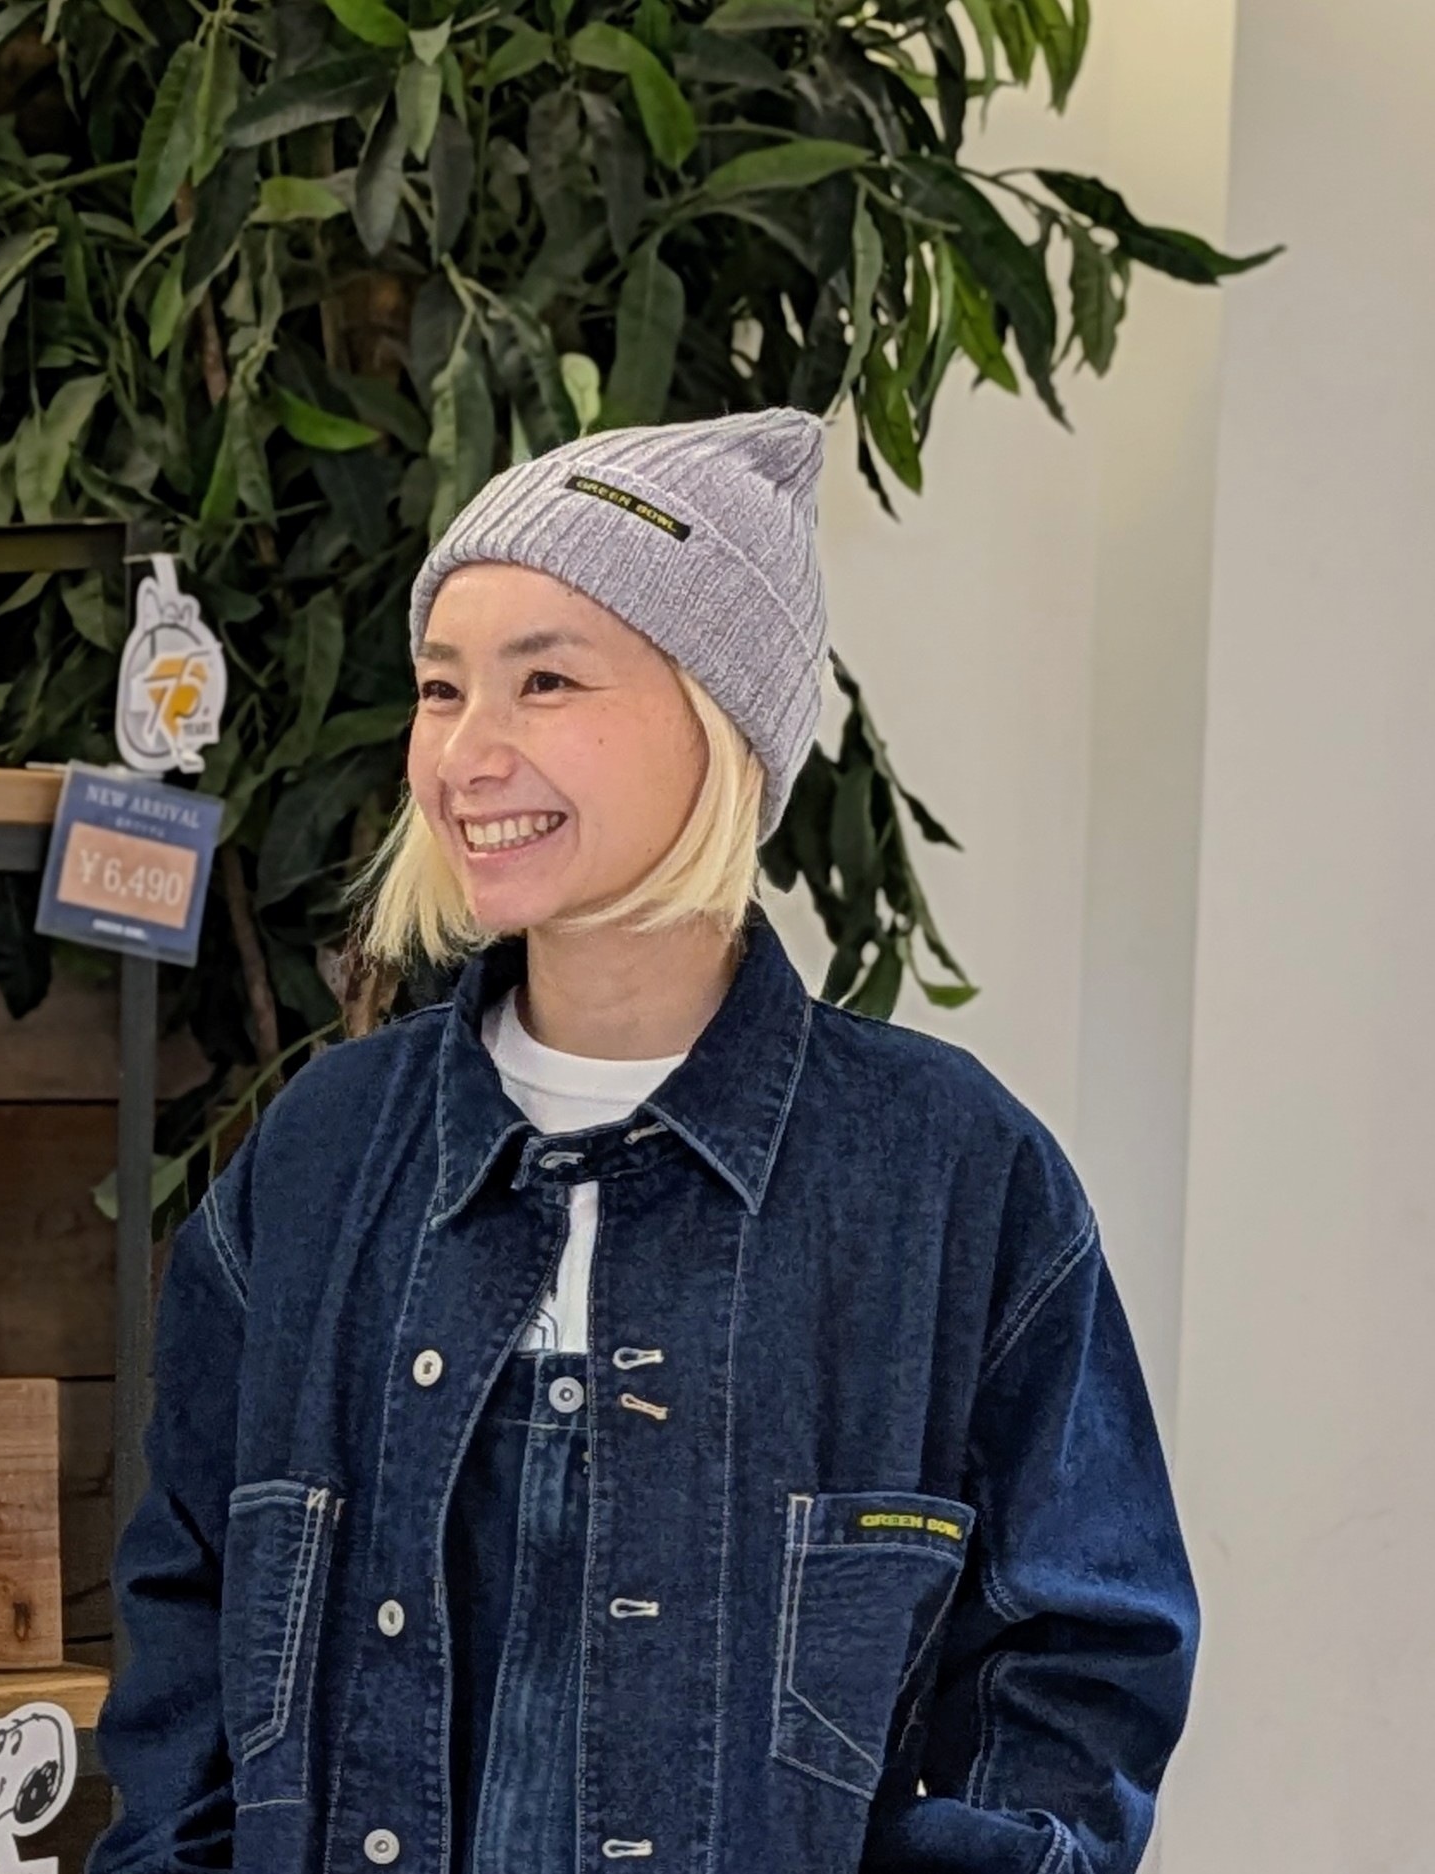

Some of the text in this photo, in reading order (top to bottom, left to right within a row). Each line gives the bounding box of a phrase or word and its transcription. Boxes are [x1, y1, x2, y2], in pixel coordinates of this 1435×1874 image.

[576, 479, 677, 533] GREEN BOWL
[85, 784, 127, 808] NEW
[128, 797, 200, 829] ARRIVAL
[861, 1513, 923, 1529] GREEN
